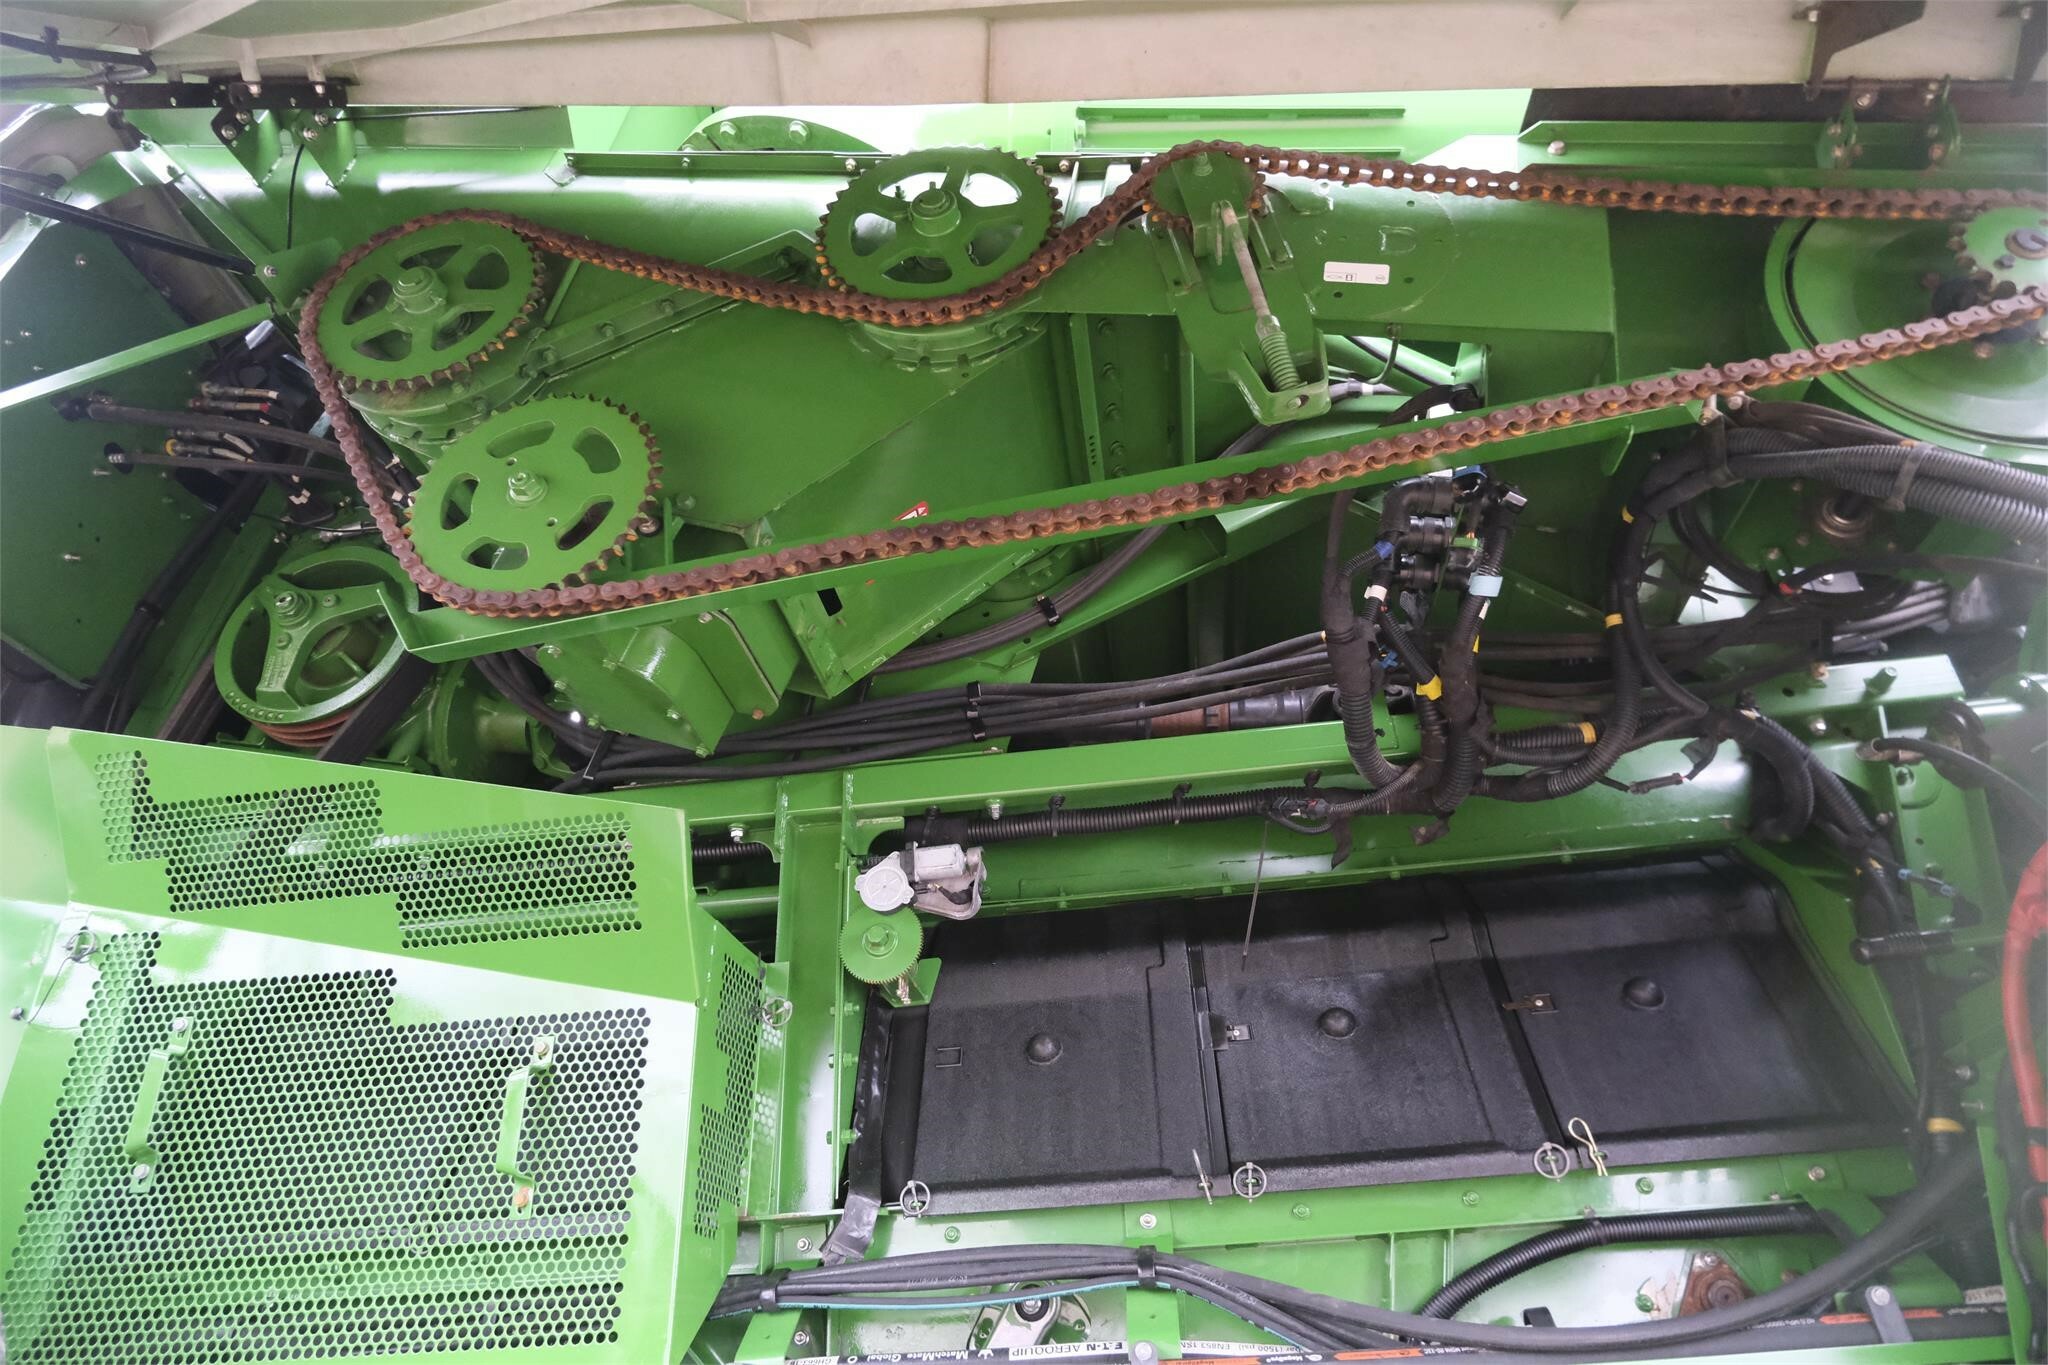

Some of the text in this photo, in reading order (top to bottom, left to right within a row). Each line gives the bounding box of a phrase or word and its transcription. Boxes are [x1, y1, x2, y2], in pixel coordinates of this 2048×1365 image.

[1012, 1344, 1081, 1356] AEROQUIP
[866, 1350, 970, 1363] MatchMate Global
